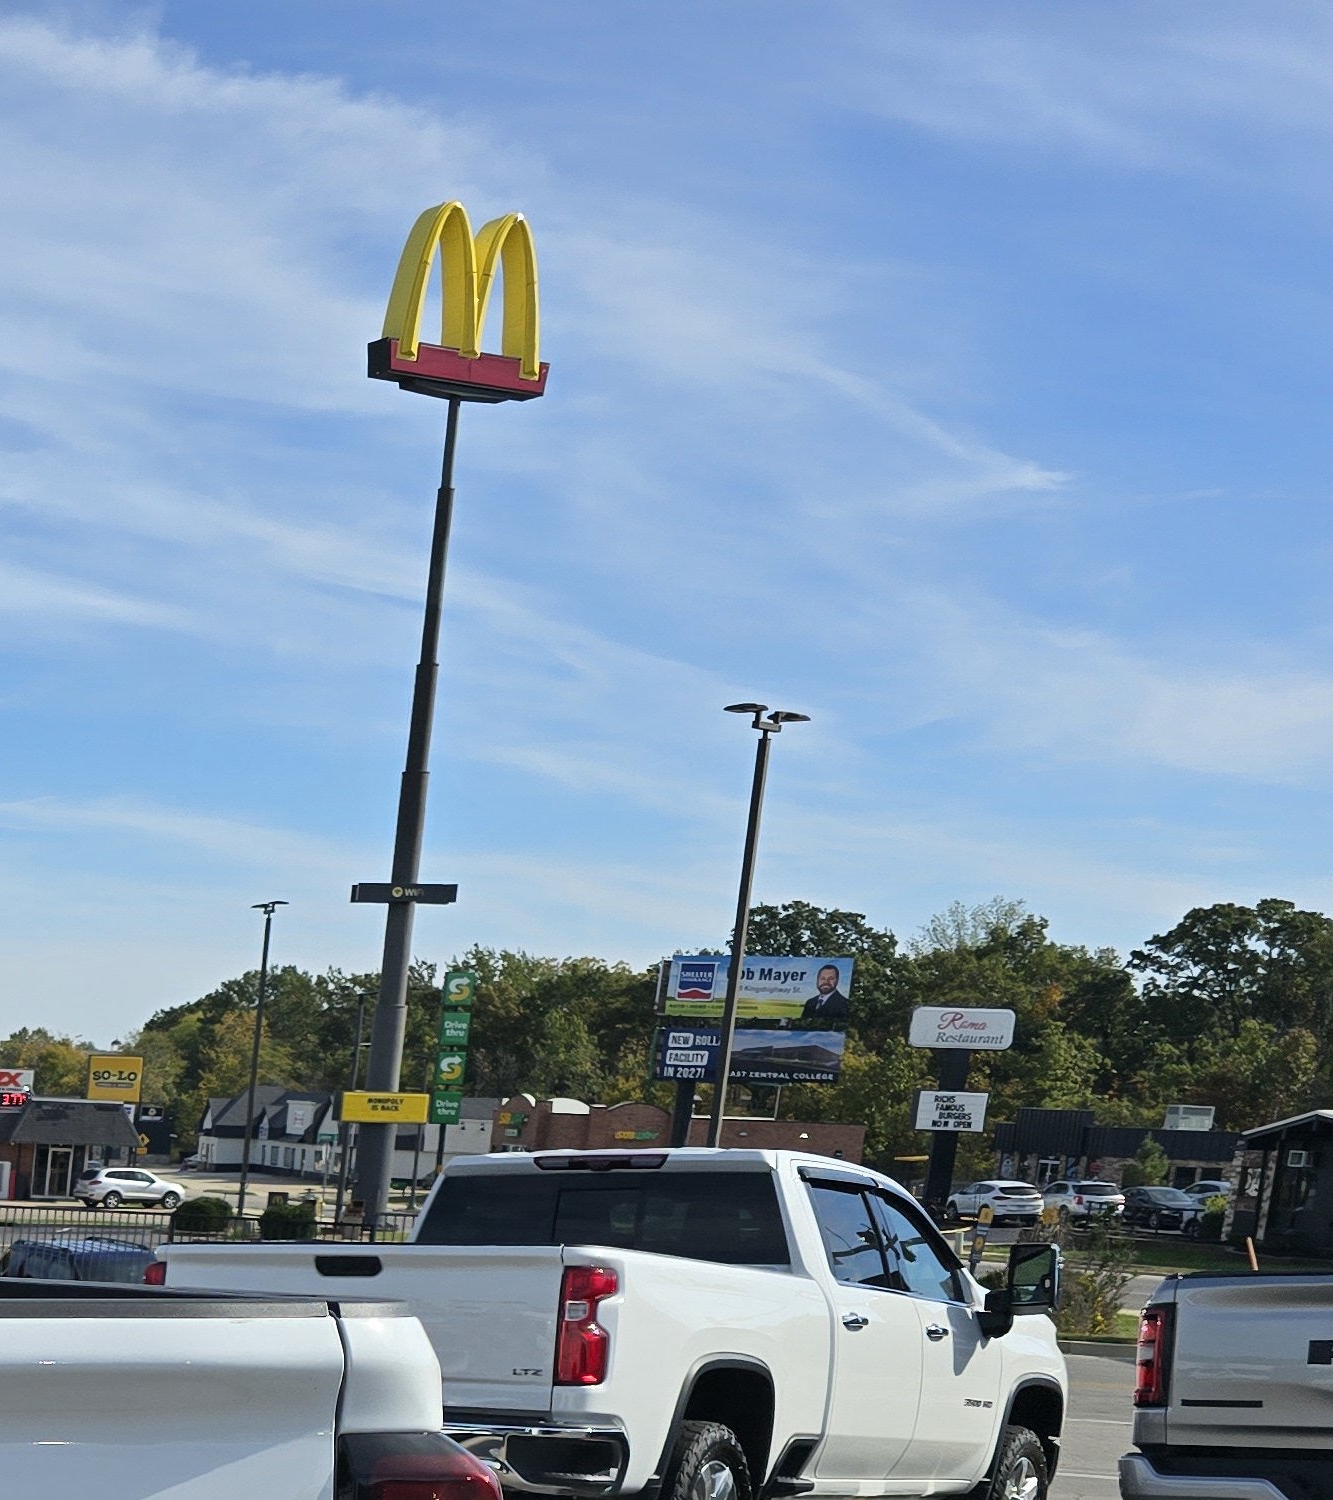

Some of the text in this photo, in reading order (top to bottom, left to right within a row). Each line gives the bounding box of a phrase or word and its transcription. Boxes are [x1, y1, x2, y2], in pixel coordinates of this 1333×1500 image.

[759, 967, 807, 984] Mayer
[444, 1020, 467, 1030] Drive
[445, 1029, 465, 1037] thru
[671, 1035, 721, 1046] NEW ROLL
[935, 1032, 1004, 1045] Restaurant
[669, 1052, 706, 1063] FACILITY
[92, 1070, 137, 1082] SO-LO
[663, 1066, 706, 1078] IN 2027!
[729, 1070, 834, 1081] AST CENTRAL COLLEGE
[435, 1100, 459, 1109] Drive
[935, 1103, 966, 1112] FAMOUS
[437, 1107, 456, 1116] thru
[938, 1112, 972, 1120] BURGERS
[931, 1120, 972, 1128] NOW OPEN
